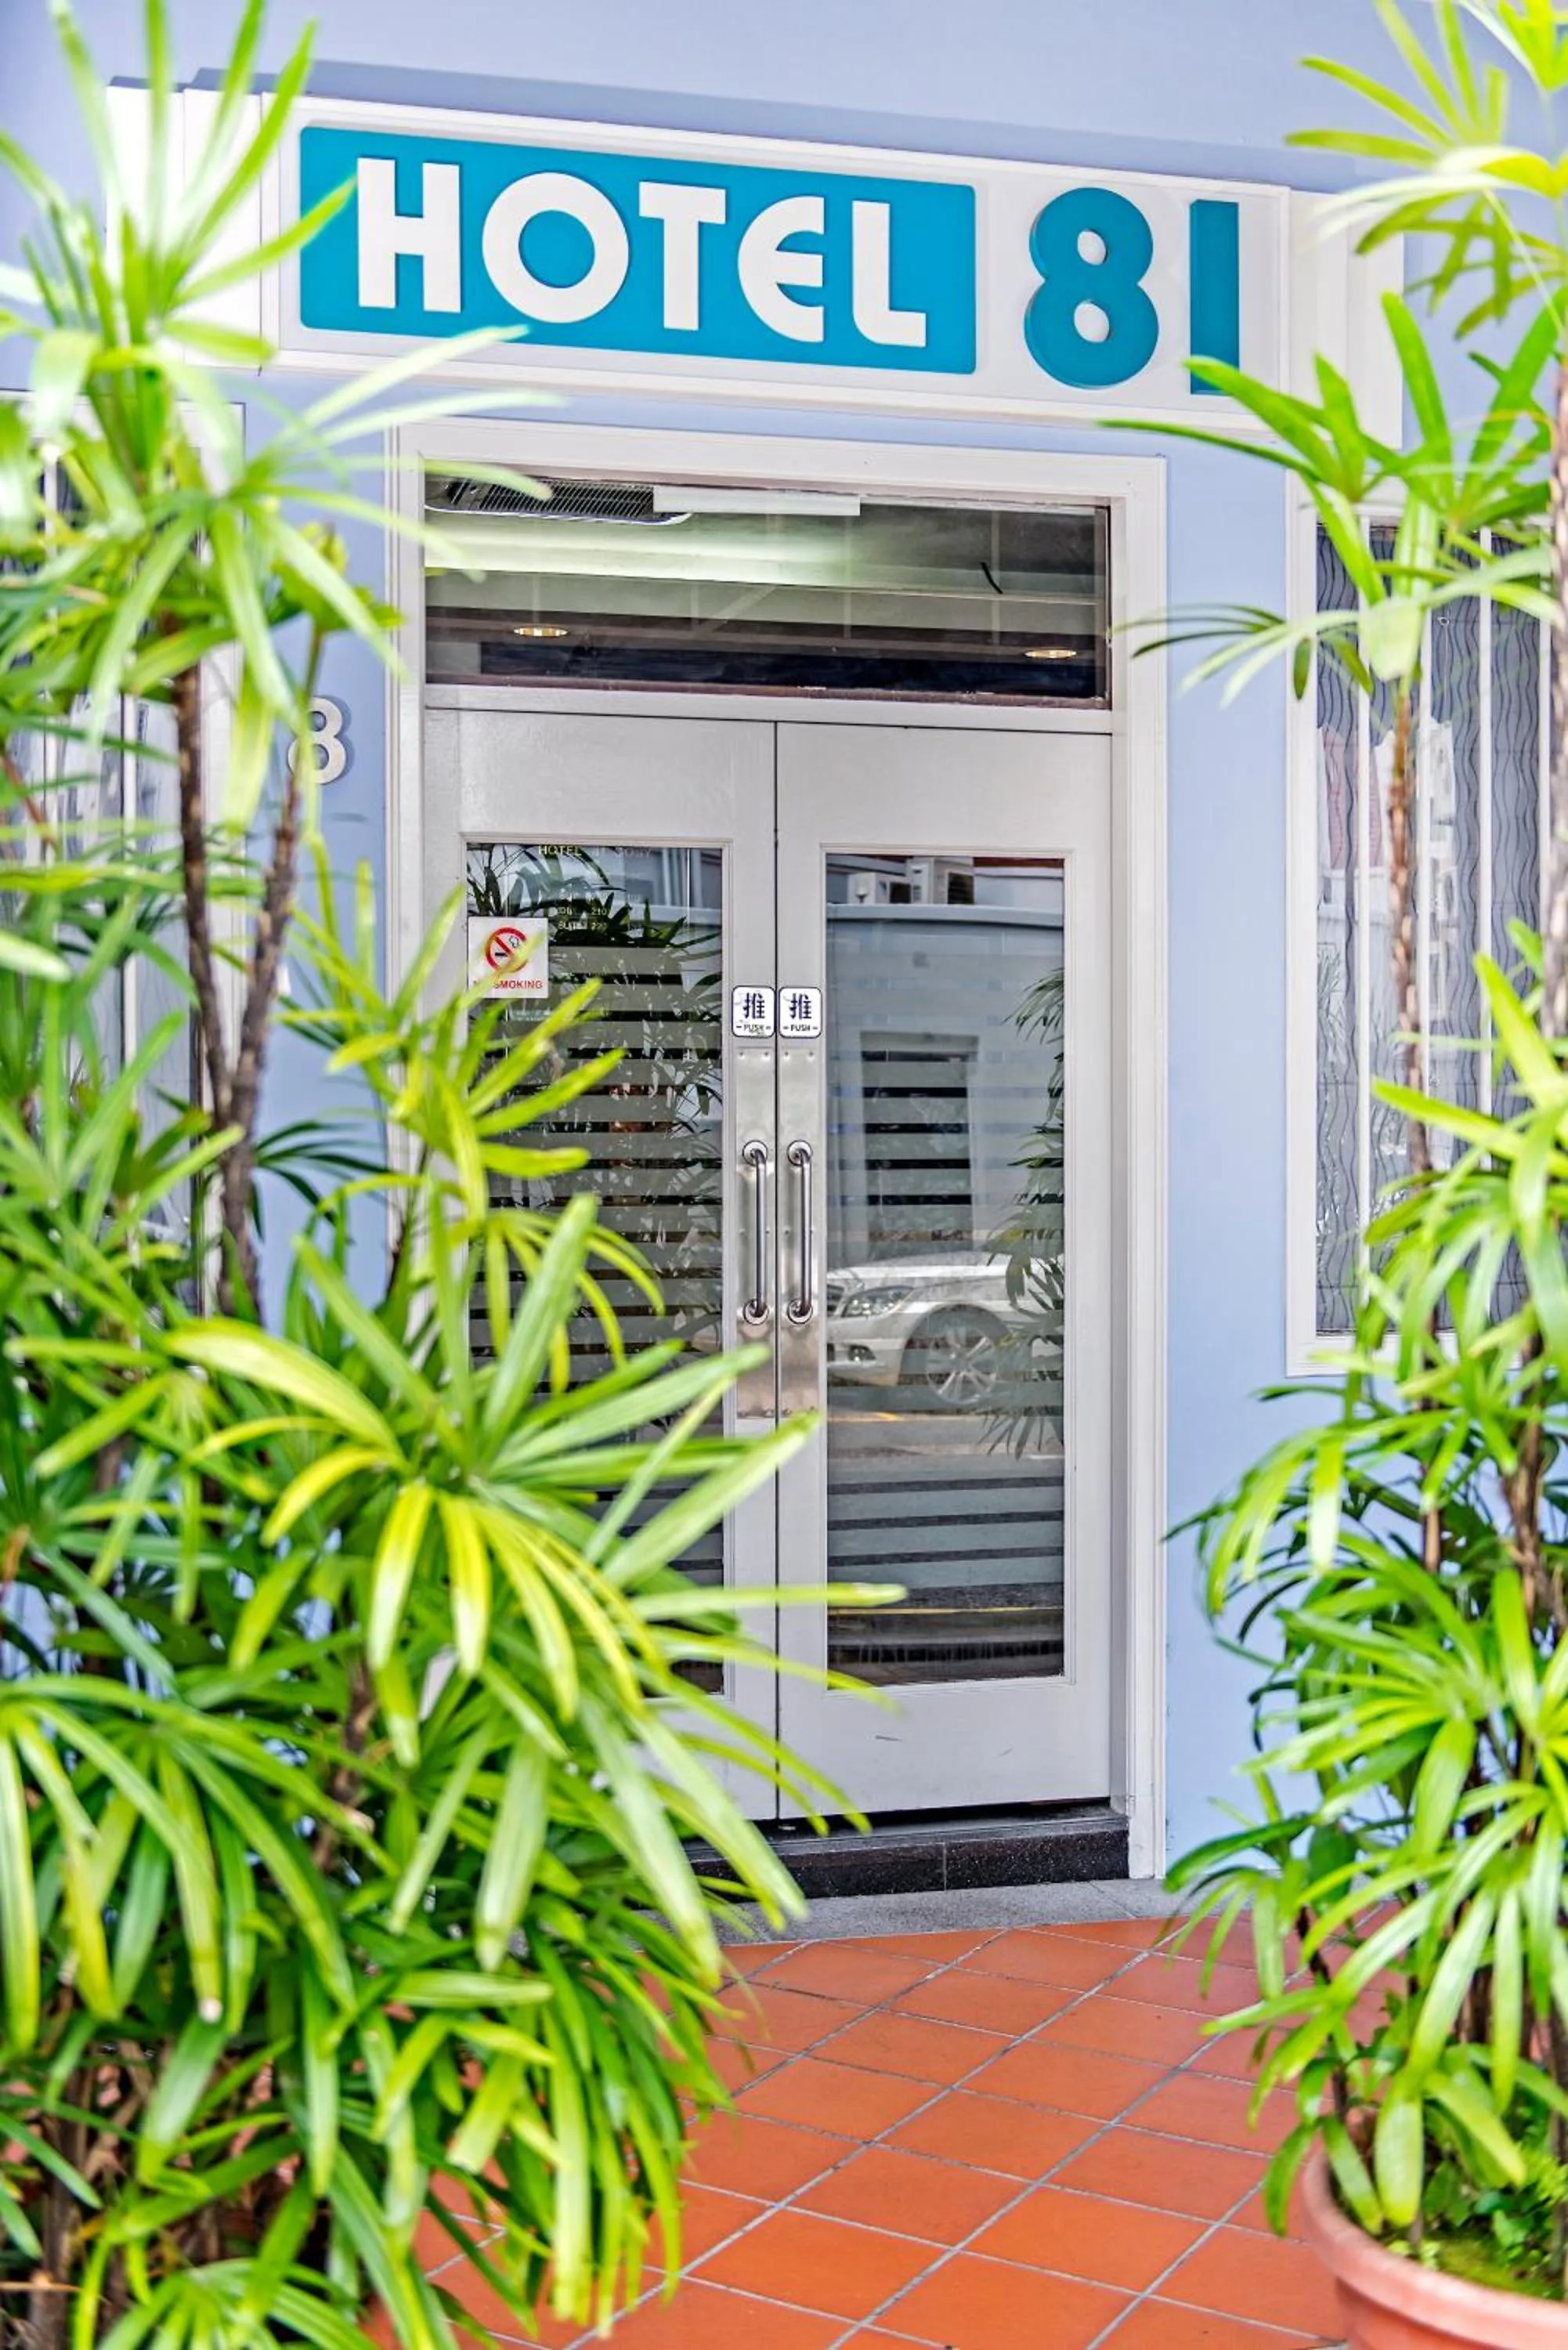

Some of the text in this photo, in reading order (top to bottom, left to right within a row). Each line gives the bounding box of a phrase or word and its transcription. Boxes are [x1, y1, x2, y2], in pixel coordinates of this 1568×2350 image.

[356, 157, 1241, 396] HOTEL 81
[287, 696, 347, 784] 8
[538, 845, 582, 857] HOTEL
[742, 992, 765, 1019] 推
[789, 992, 812, 1020] 推
